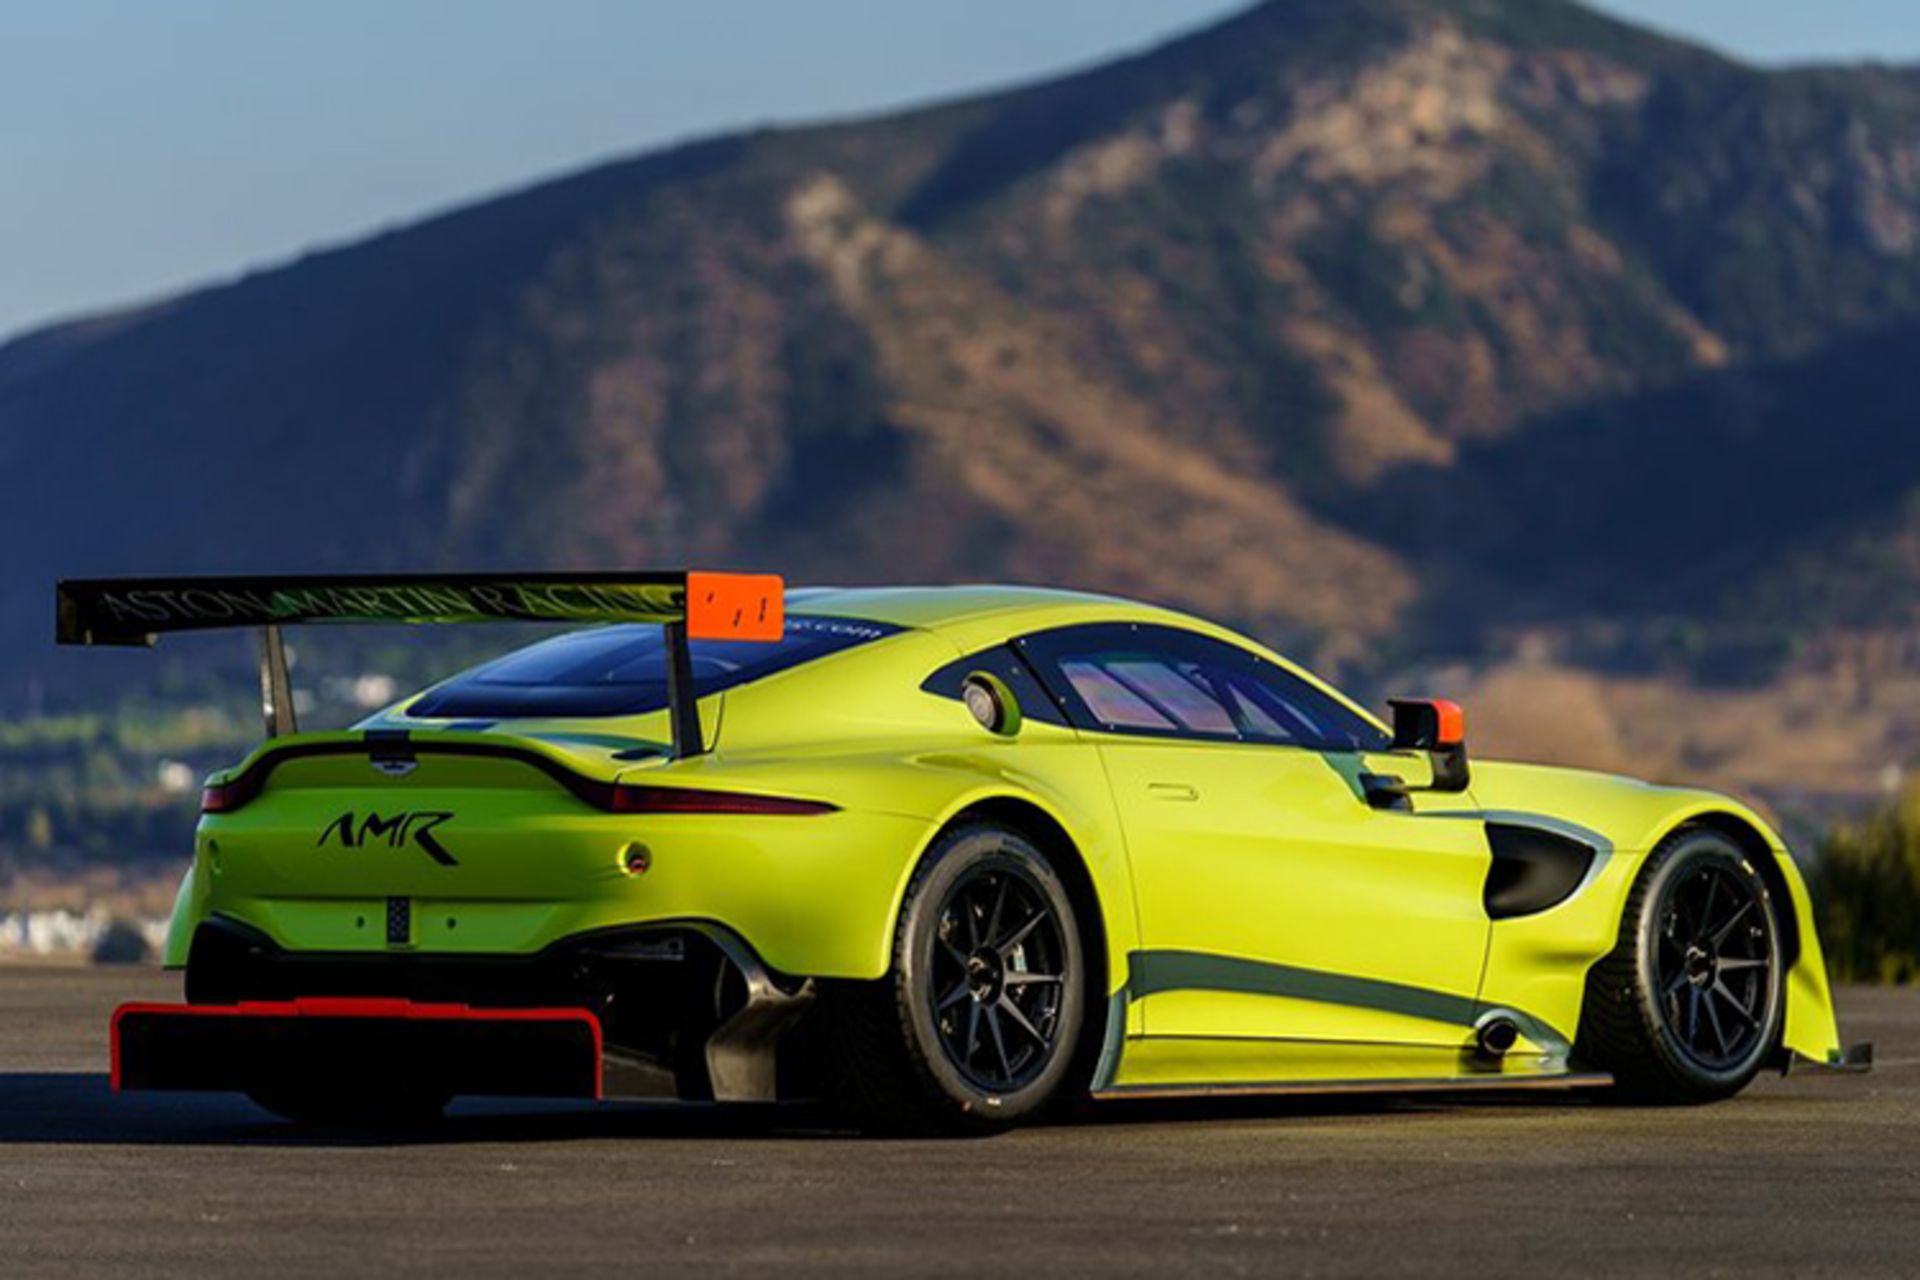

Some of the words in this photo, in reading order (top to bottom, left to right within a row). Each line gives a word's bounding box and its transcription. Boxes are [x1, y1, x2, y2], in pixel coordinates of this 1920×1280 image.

[101, 588, 274, 621] ASTON
[270, 586, 480, 617] MARTIN
[317, 811, 460, 867] AMR
